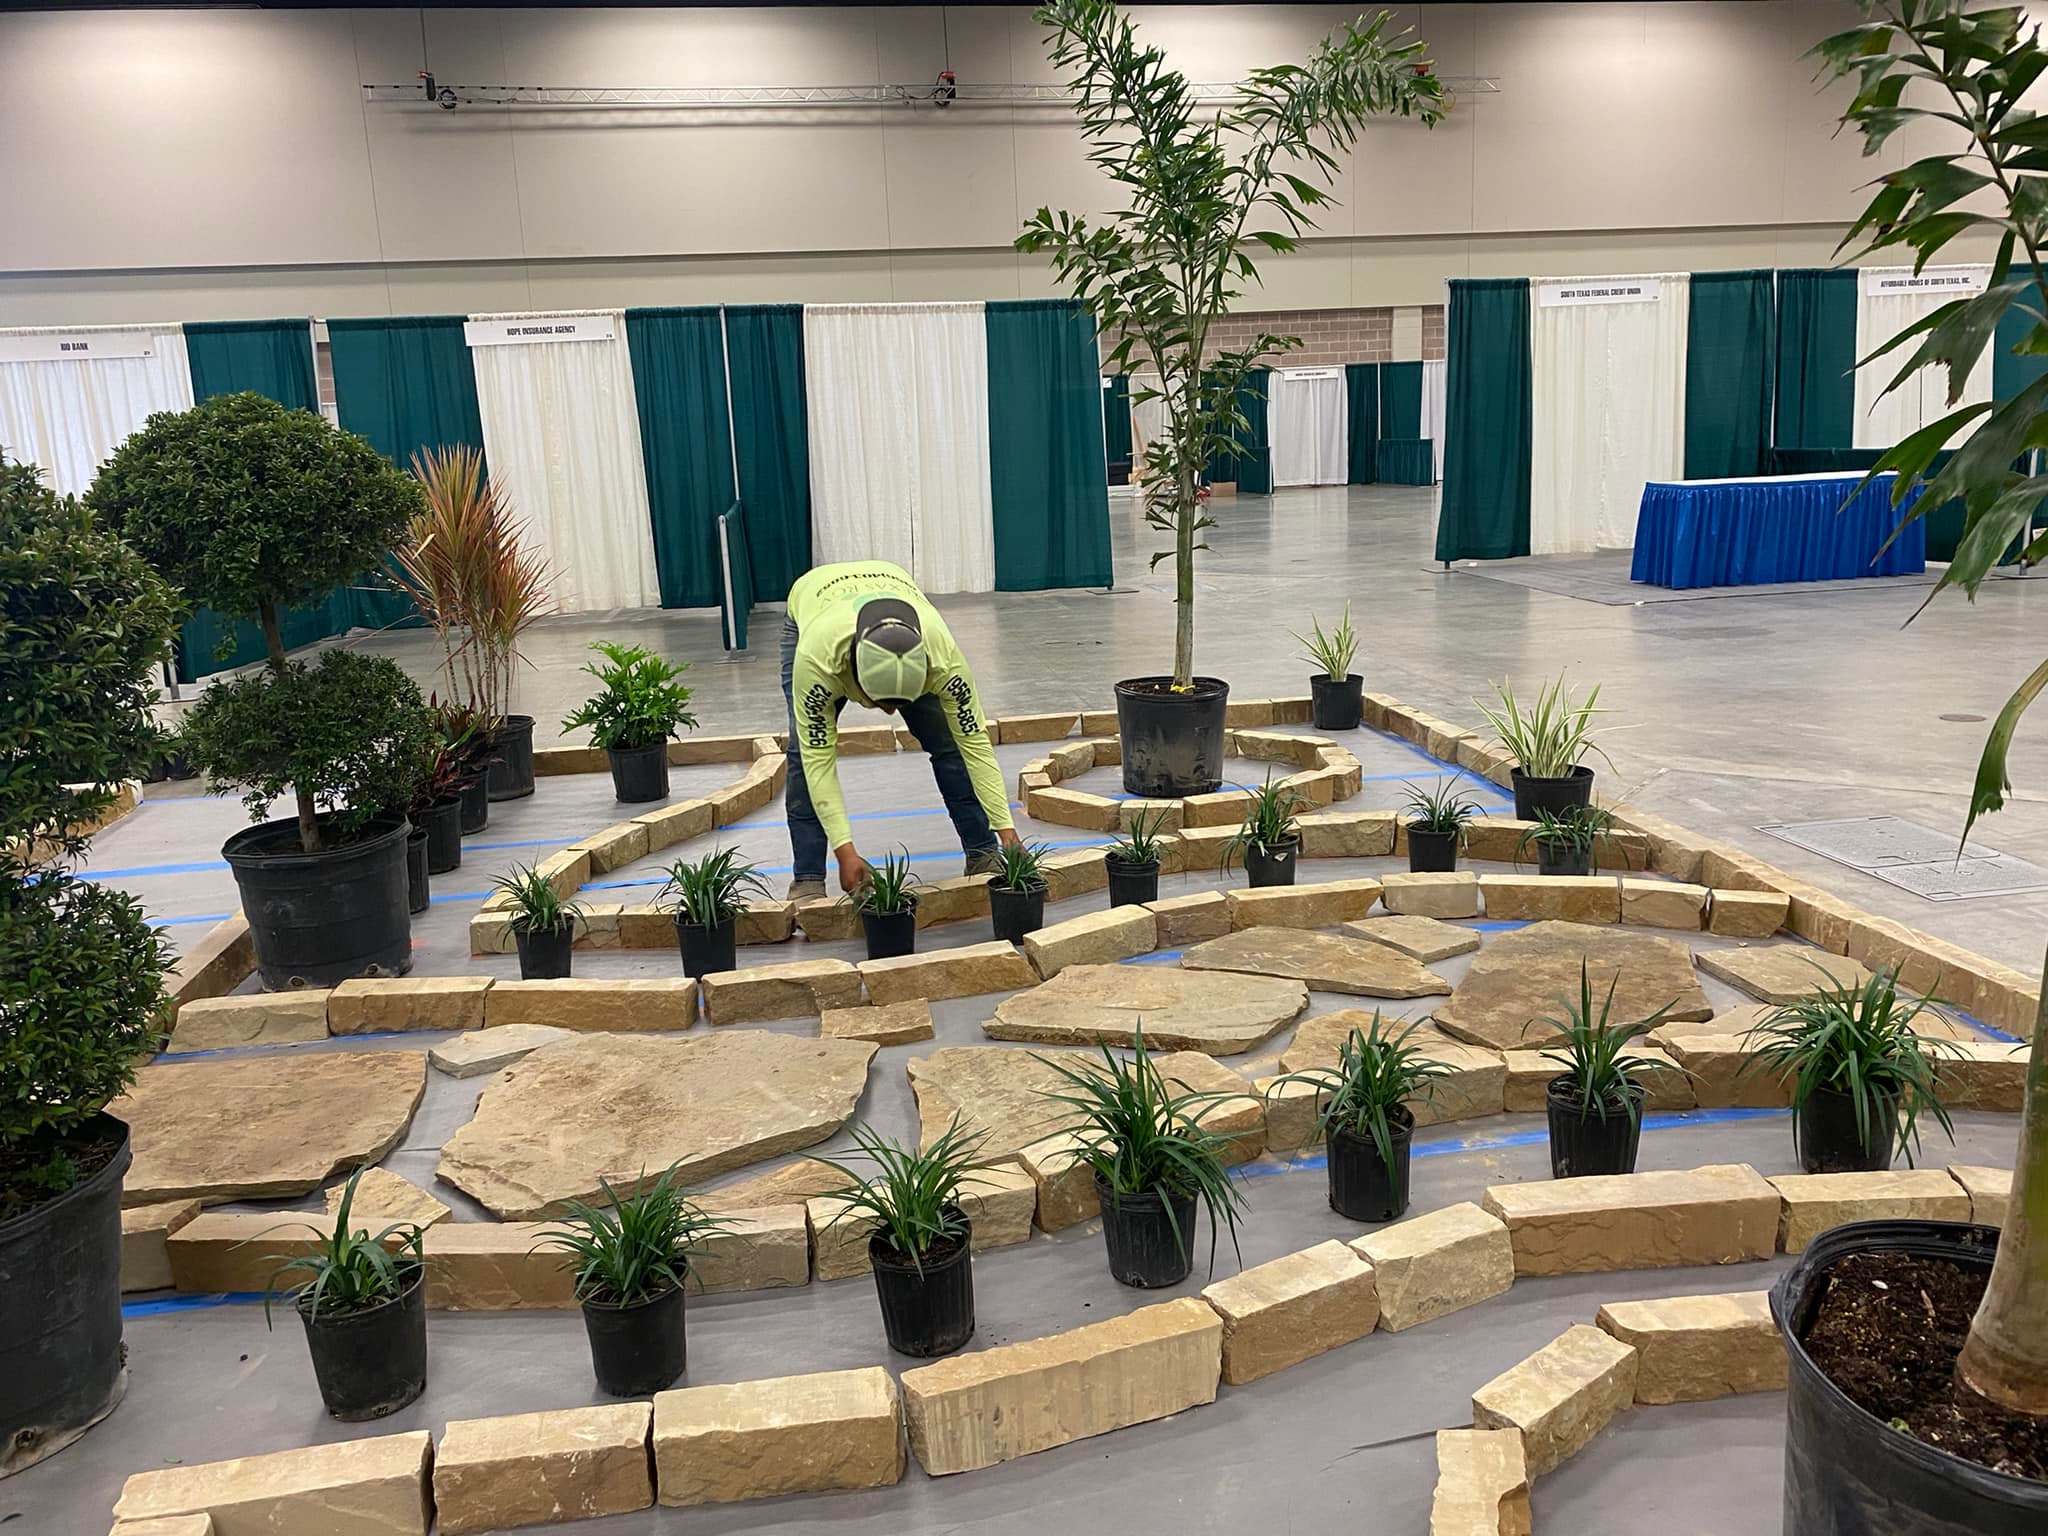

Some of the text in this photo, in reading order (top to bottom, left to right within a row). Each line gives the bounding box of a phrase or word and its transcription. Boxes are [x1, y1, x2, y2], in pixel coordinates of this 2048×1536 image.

[1908, 279, 1923, 287] HOMES
[1924, 278, 1930, 286] OF
[1931, 278, 1945, 286] SOUTH
[1560, 287, 1641, 298] SOUTH TEXAS FEDERAL CREDIT UNION
[522, 326, 553, 335] INSURANCE
[554, 325, 576, 334] AGENCY
[72, 343, 88, 351] BANK
